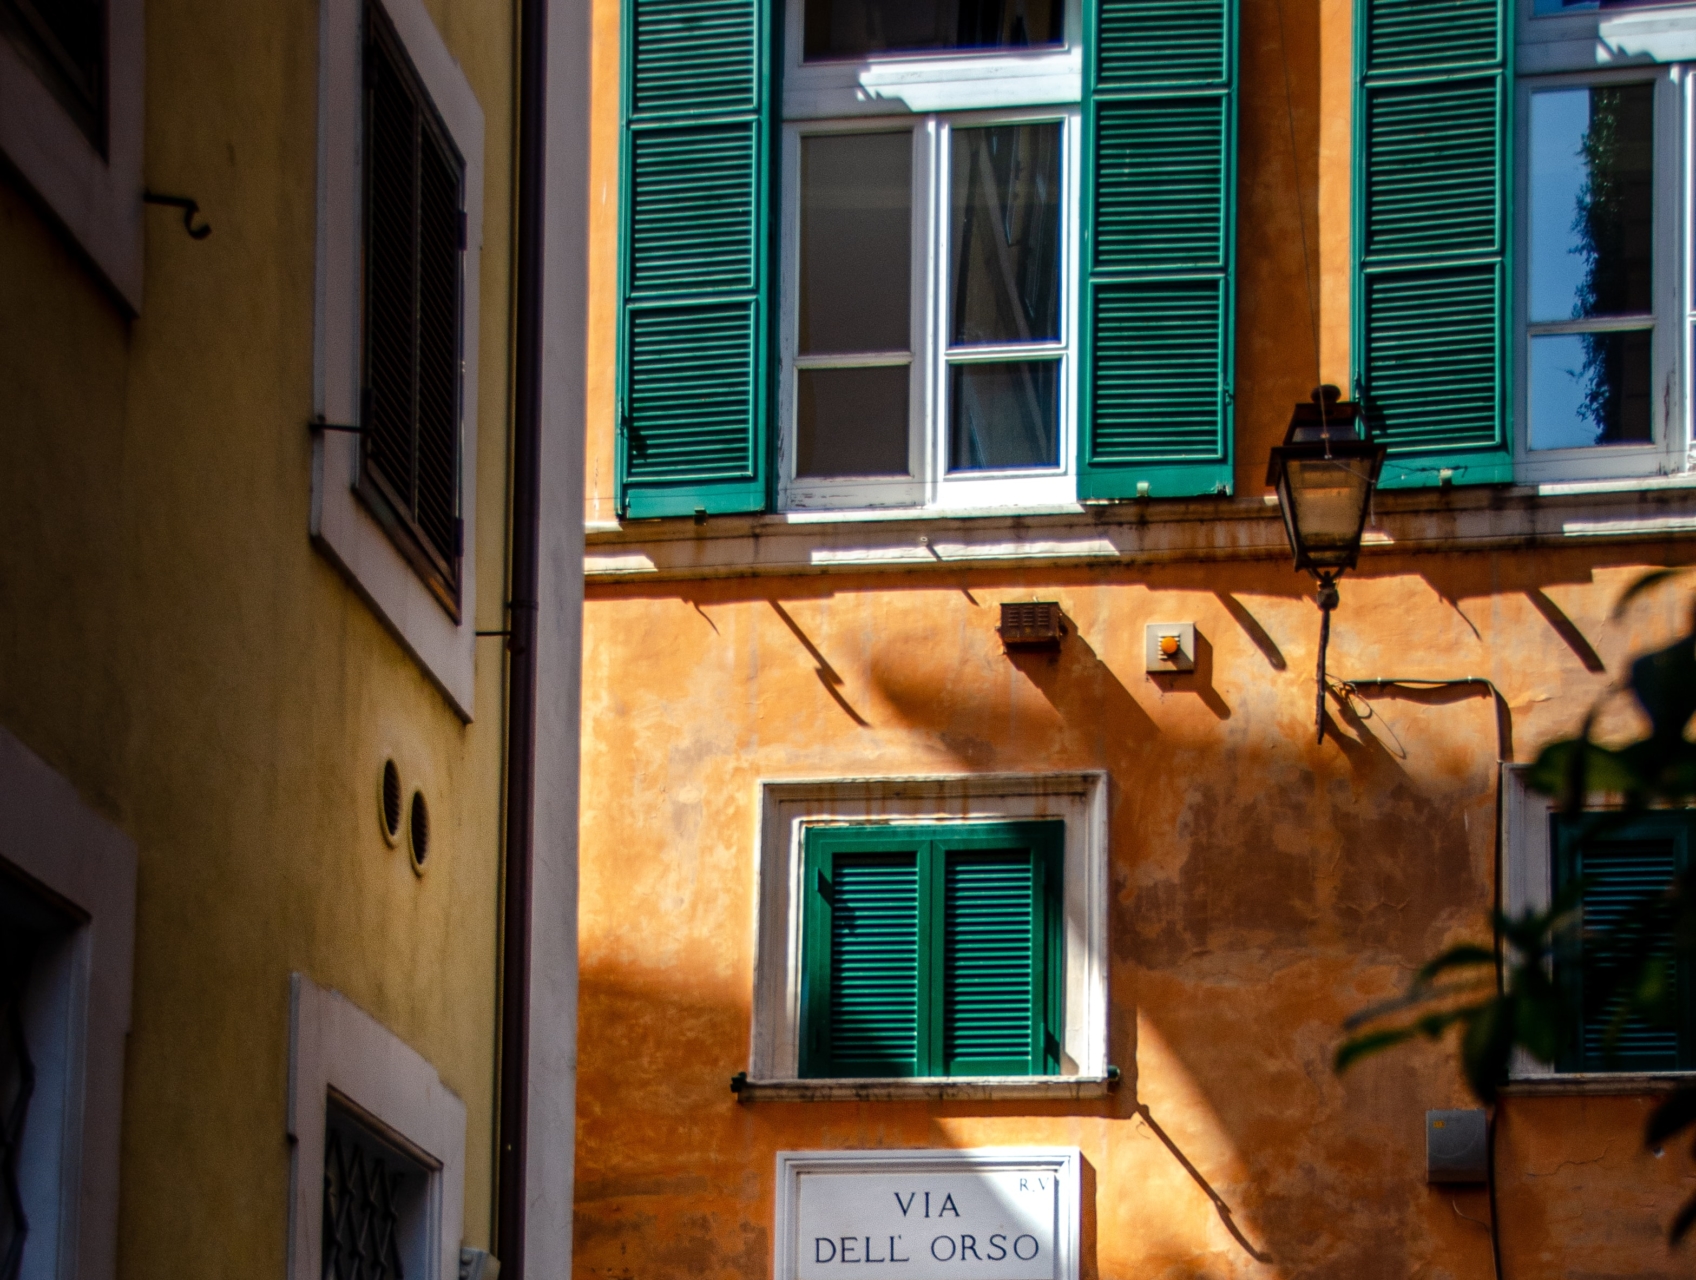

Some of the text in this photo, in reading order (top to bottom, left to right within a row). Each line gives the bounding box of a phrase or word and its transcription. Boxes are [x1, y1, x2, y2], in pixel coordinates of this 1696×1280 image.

[893, 1191, 961, 1218] VIA
[815, 1234, 1040, 1263] DELL' ORSO
